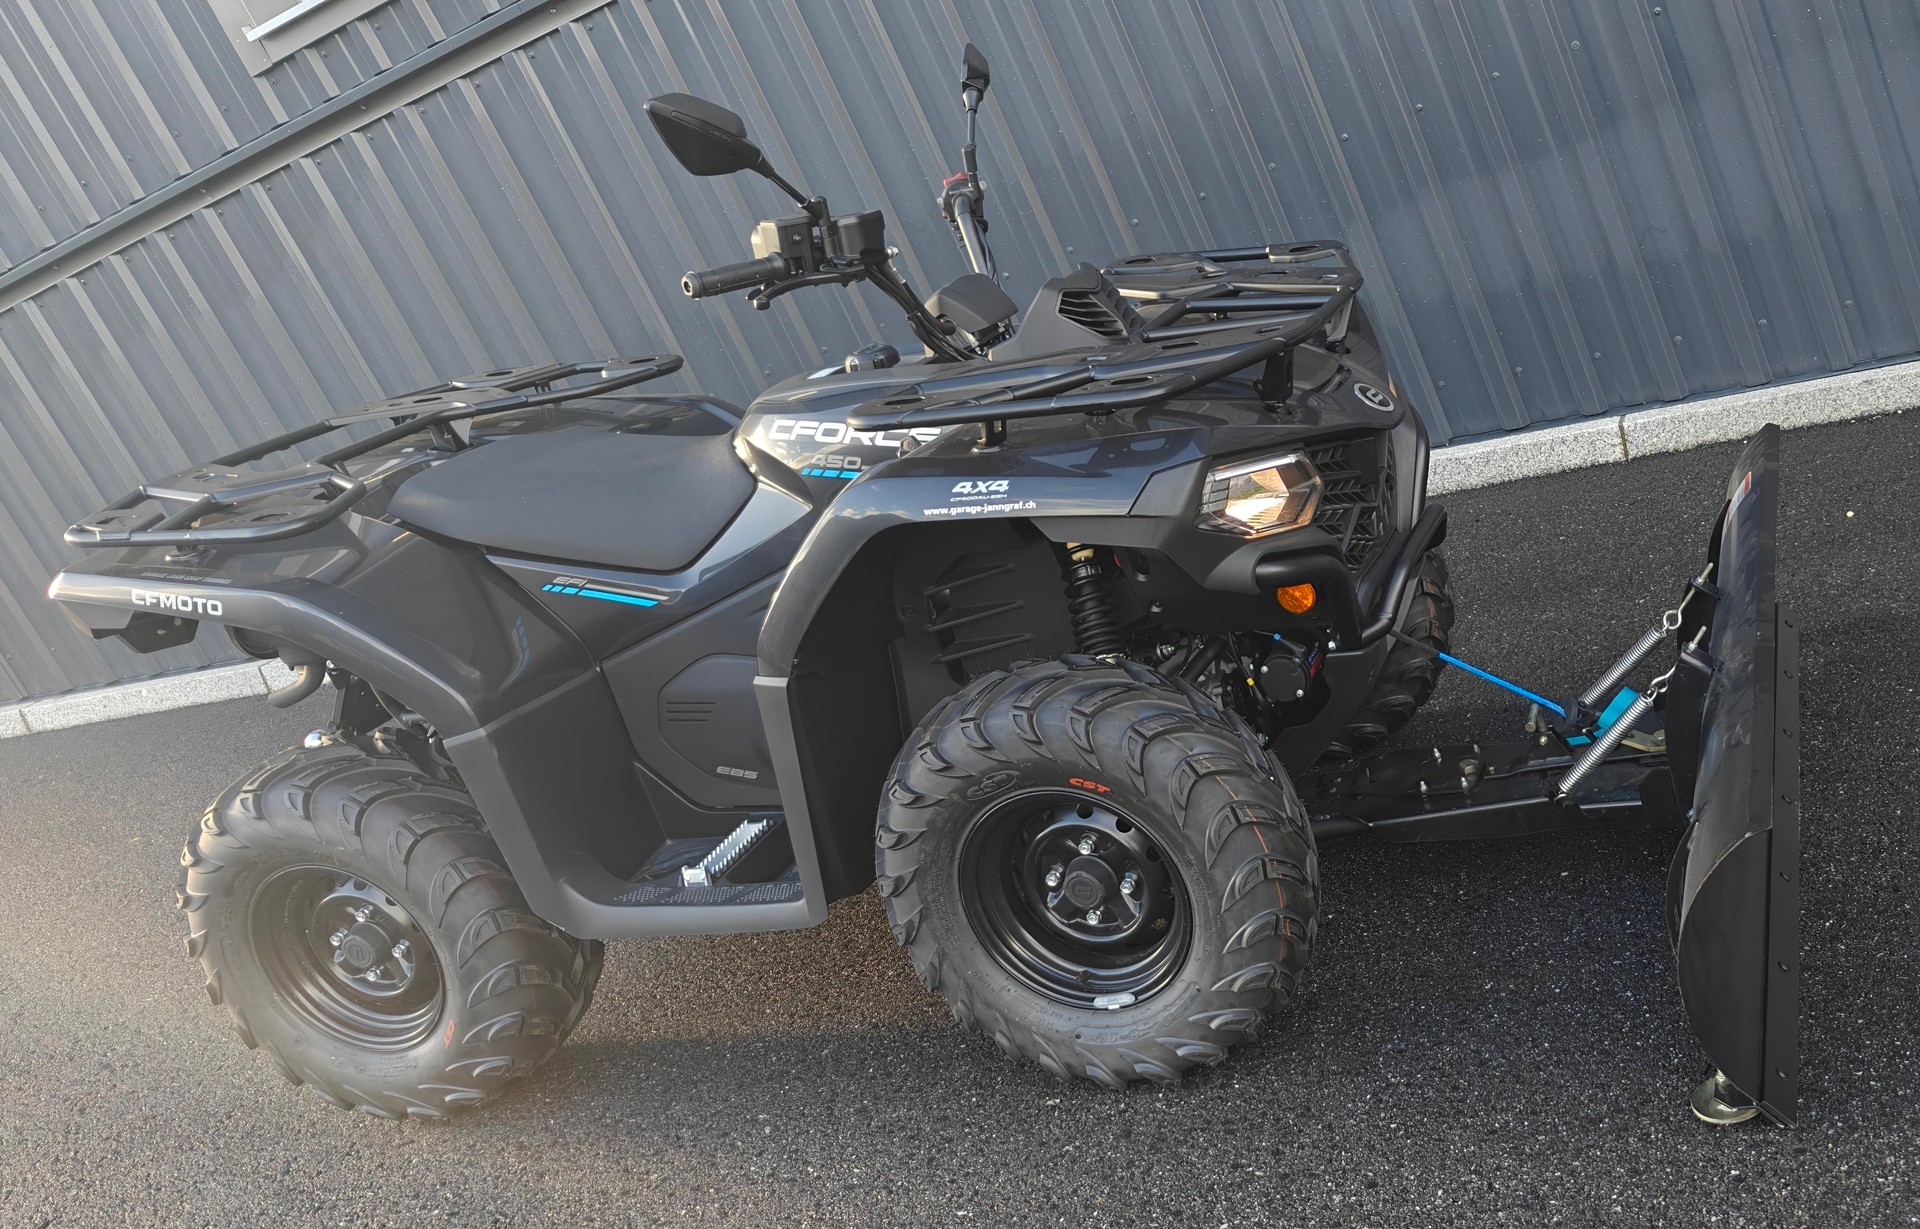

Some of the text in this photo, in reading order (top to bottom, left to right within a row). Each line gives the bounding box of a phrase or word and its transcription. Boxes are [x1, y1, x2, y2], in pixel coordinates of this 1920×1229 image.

[768, 418, 943, 447] CFORCE
[810, 454, 862, 470] 450
[922, 500, 1037, 516] www.garage-janngraf.ch
[552, 576, 588, 587] EFI
[131, 588, 223, 616] CFMOTO
[716, 765, 759, 779] EBS
[1068, 777, 1111, 794] CST
